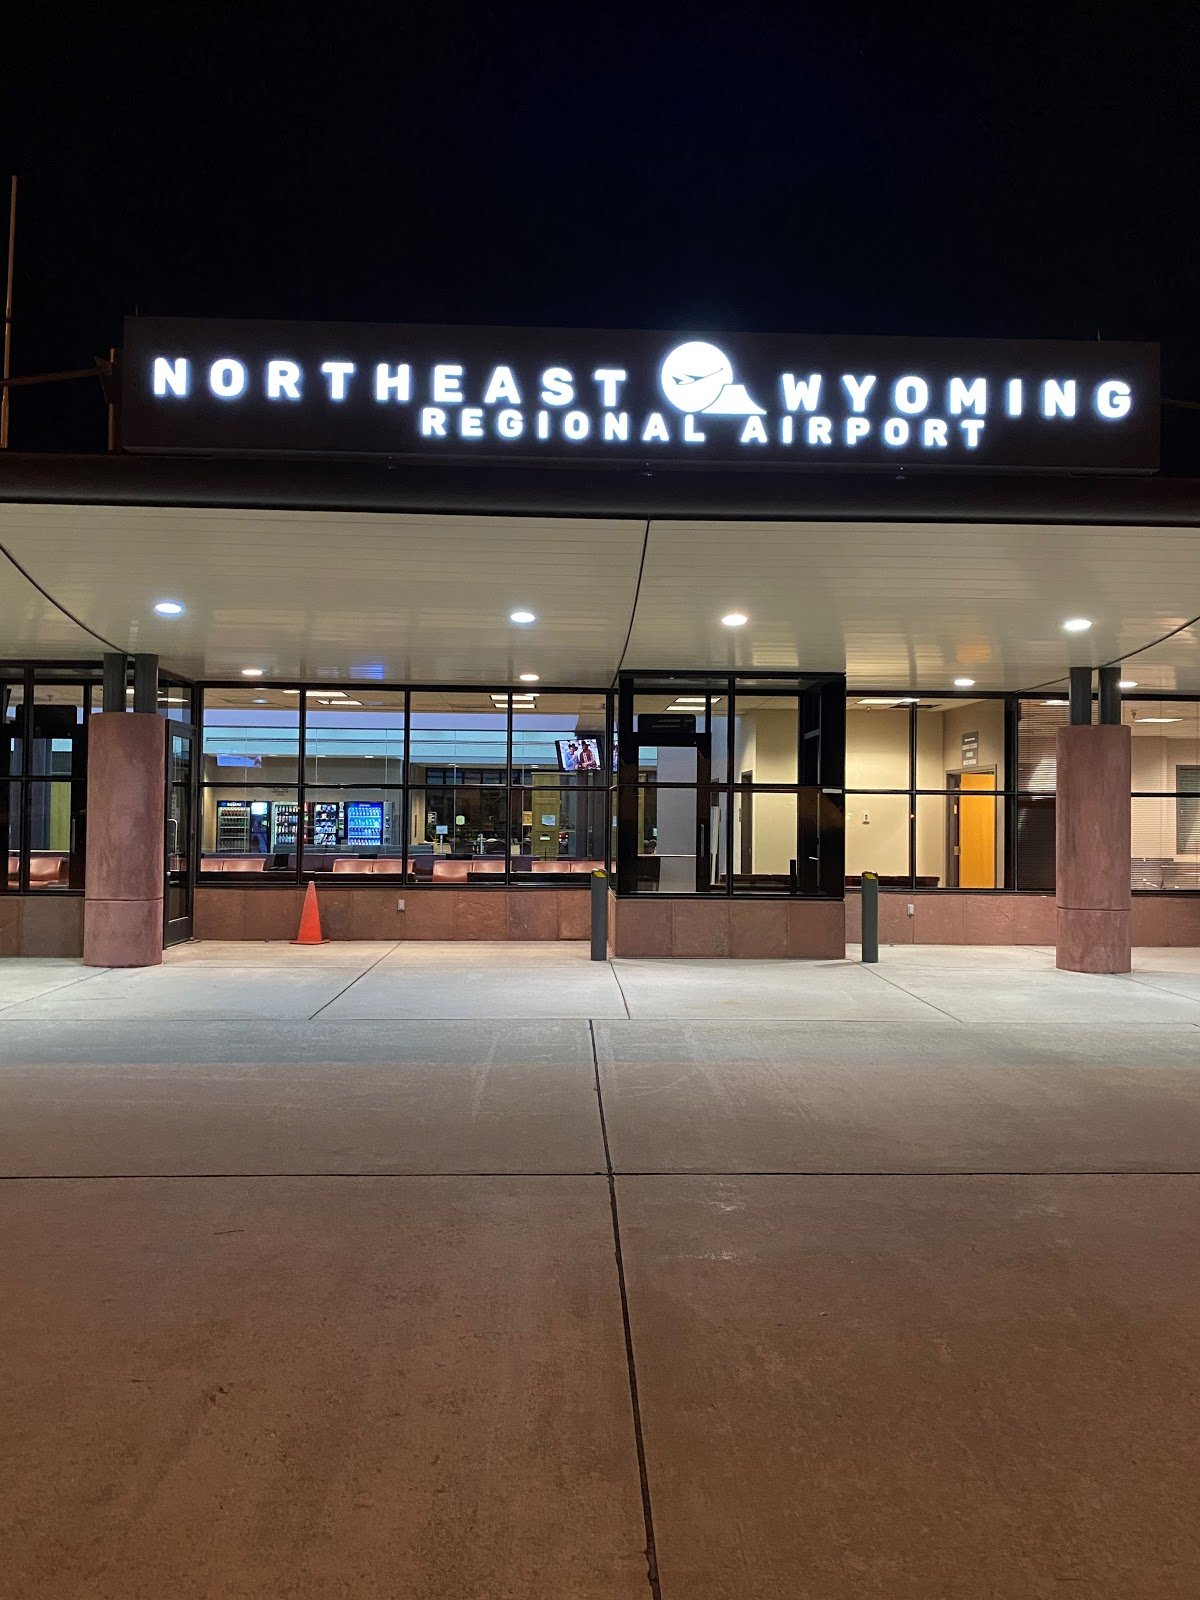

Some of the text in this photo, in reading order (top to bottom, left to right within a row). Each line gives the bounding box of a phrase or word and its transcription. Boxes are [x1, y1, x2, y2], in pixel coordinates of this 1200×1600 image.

[152, 356, 1133, 420] NORTHEAST WYOMING
[420, 406, 987, 449] REGIONAL AIRPORT
